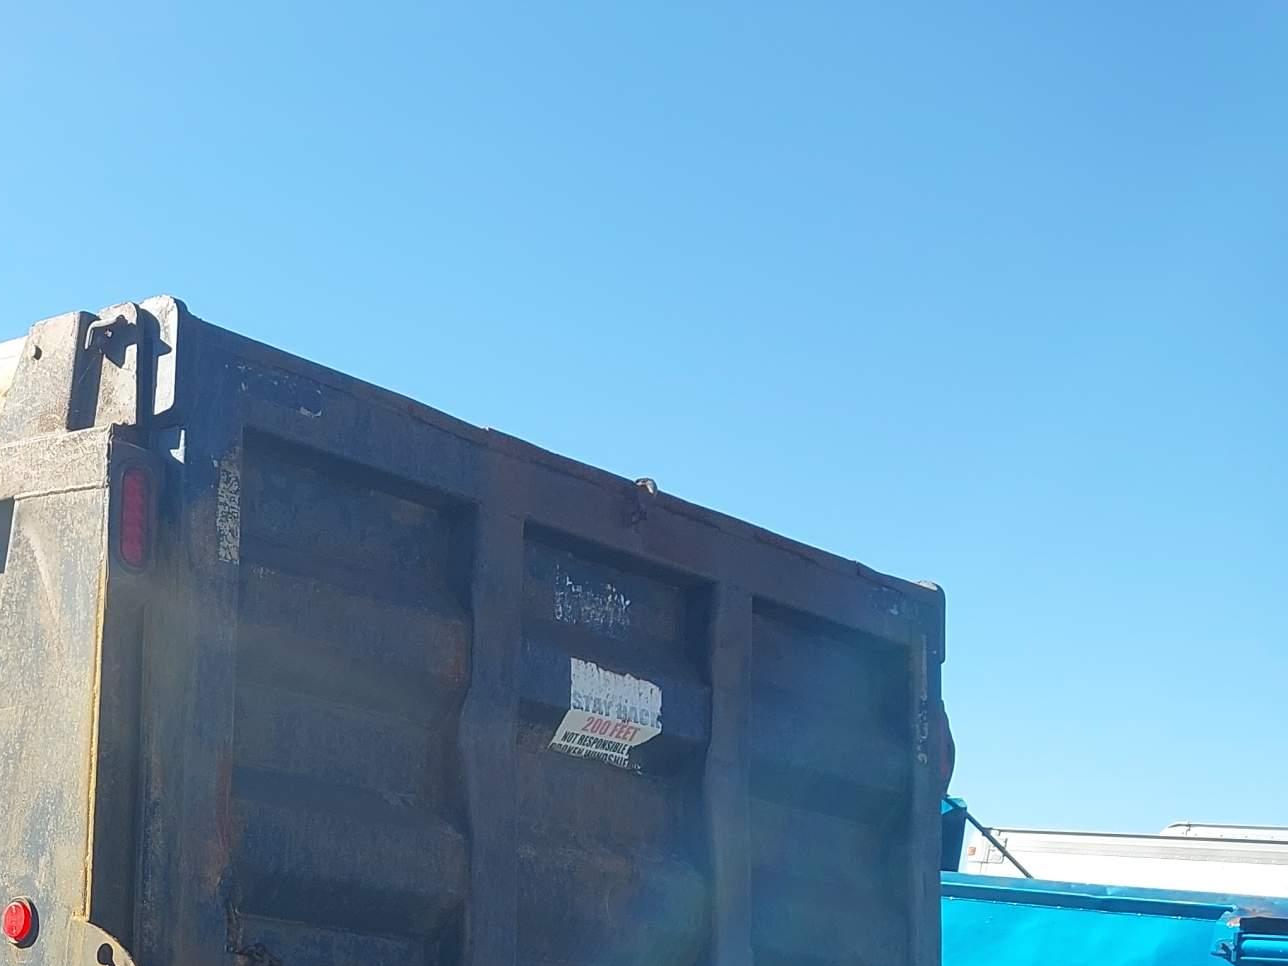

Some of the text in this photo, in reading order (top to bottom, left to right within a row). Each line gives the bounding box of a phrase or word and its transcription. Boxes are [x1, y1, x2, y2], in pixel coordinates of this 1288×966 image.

[572, 690, 612, 717] STAY
[582, 716, 640, 741] 200 FEET
[561, 730, 579, 743] NOT
[577, 733, 628, 754] RESPONSIBLE
